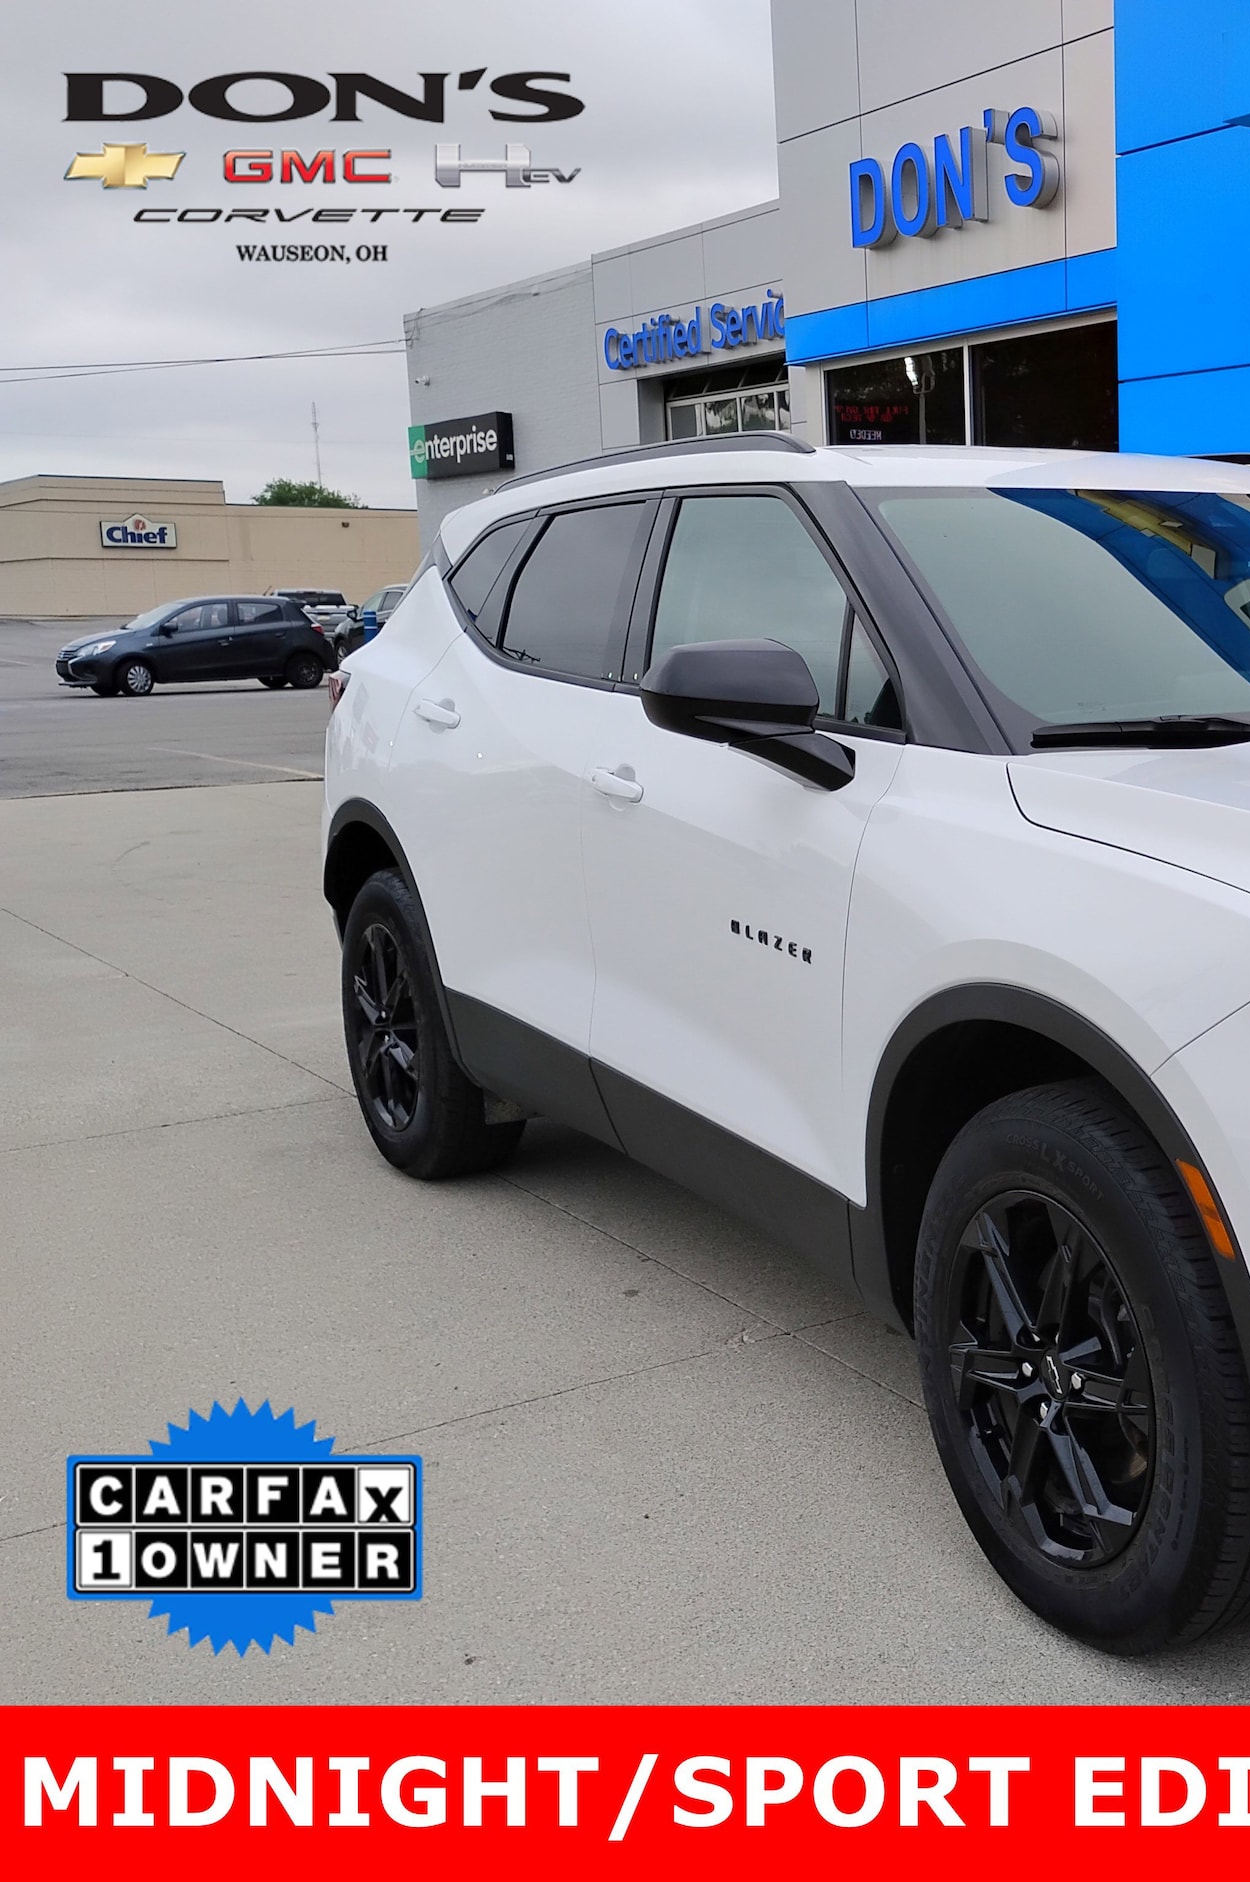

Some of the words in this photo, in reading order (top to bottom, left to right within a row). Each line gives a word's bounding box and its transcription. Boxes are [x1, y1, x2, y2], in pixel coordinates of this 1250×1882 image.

[849, 106, 1052, 249] DON'S
[603, 306, 703, 370] Certified
[411, 424, 498, 464] enterprise
[105, 525, 168, 544] Chief
[730, 919, 812, 965] BLAZER
